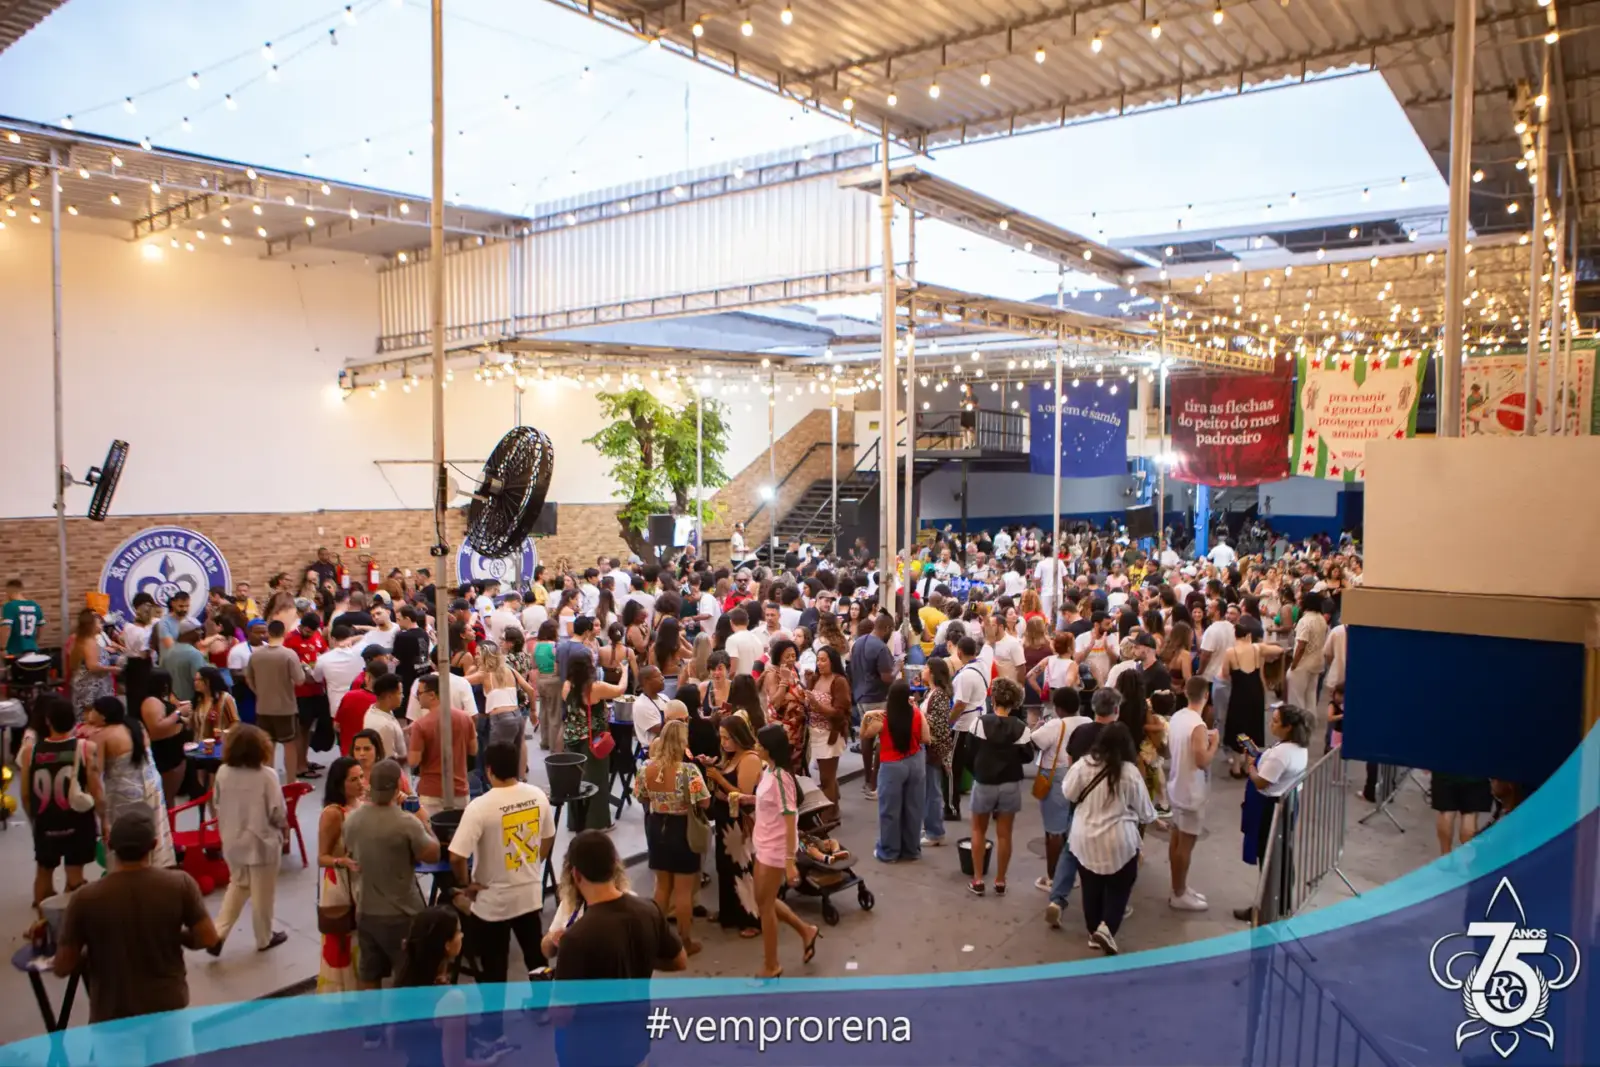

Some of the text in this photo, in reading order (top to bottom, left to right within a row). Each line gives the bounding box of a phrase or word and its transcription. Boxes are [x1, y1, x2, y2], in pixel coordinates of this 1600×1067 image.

[1329, 391, 1386, 404] pra reunir
[1184, 398, 1274, 414] tira as flechas
[1331, 404, 1382, 416] garotada
[1089, 410, 1121, 427] samba
[1178, 412, 1280, 431] do peito do meu
[1318, 417, 1394, 429] proteger meu
[1195, 430, 1262, 447] padroeiro
[1332, 429, 1379, 439] amanhã
[1218, 472, 1237, 480] volta
[108, 535, 219, 581] Renascença Clube
[19, 614, 37, 636] 13
[33, 765, 74, 814] 90
